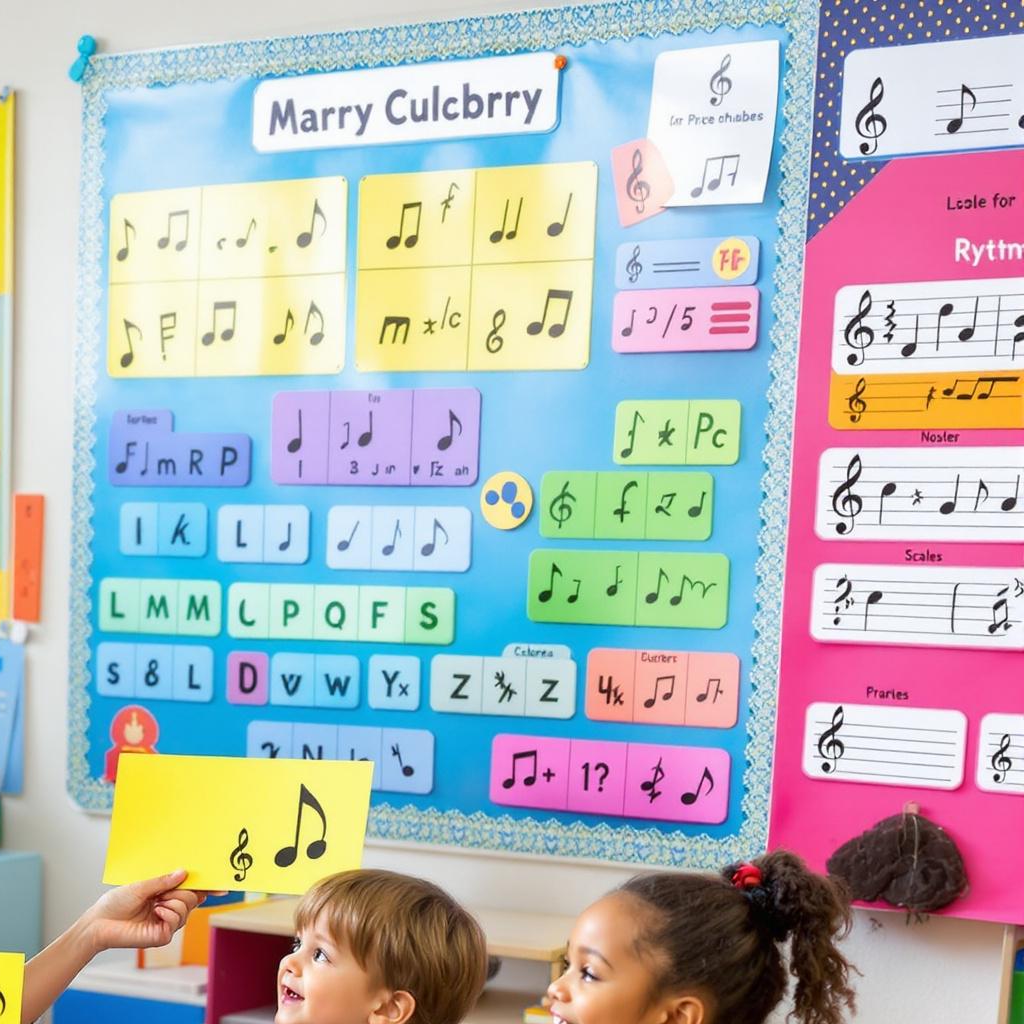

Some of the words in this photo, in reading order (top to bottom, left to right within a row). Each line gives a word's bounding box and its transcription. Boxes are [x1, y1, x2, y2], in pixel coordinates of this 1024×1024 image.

[268, 98, 374, 137] Marry
[384, 82, 543, 126] Culcbrry
[993, 192, 1017, 209] for
[188, 449, 205, 476] R
[220, 446, 239, 477] P
[236, 519, 248, 548] L
[905, 549, 943, 563] Scales
[110, 591, 126, 619] L
[146, 595, 170, 620] M
[186, 595, 211, 622] M
[282, 600, 300, 627] P
[325, 601, 347, 630] Q
[371, 601, 389, 629] F
[419, 602, 439, 630] S
[106, 663, 120, 685] S
[187, 664, 202, 690] L
[238, 662, 258, 694] D
[325, 674, 351, 698] W
[450, 673, 472, 700] Z
[539, 678, 560, 703] Z
